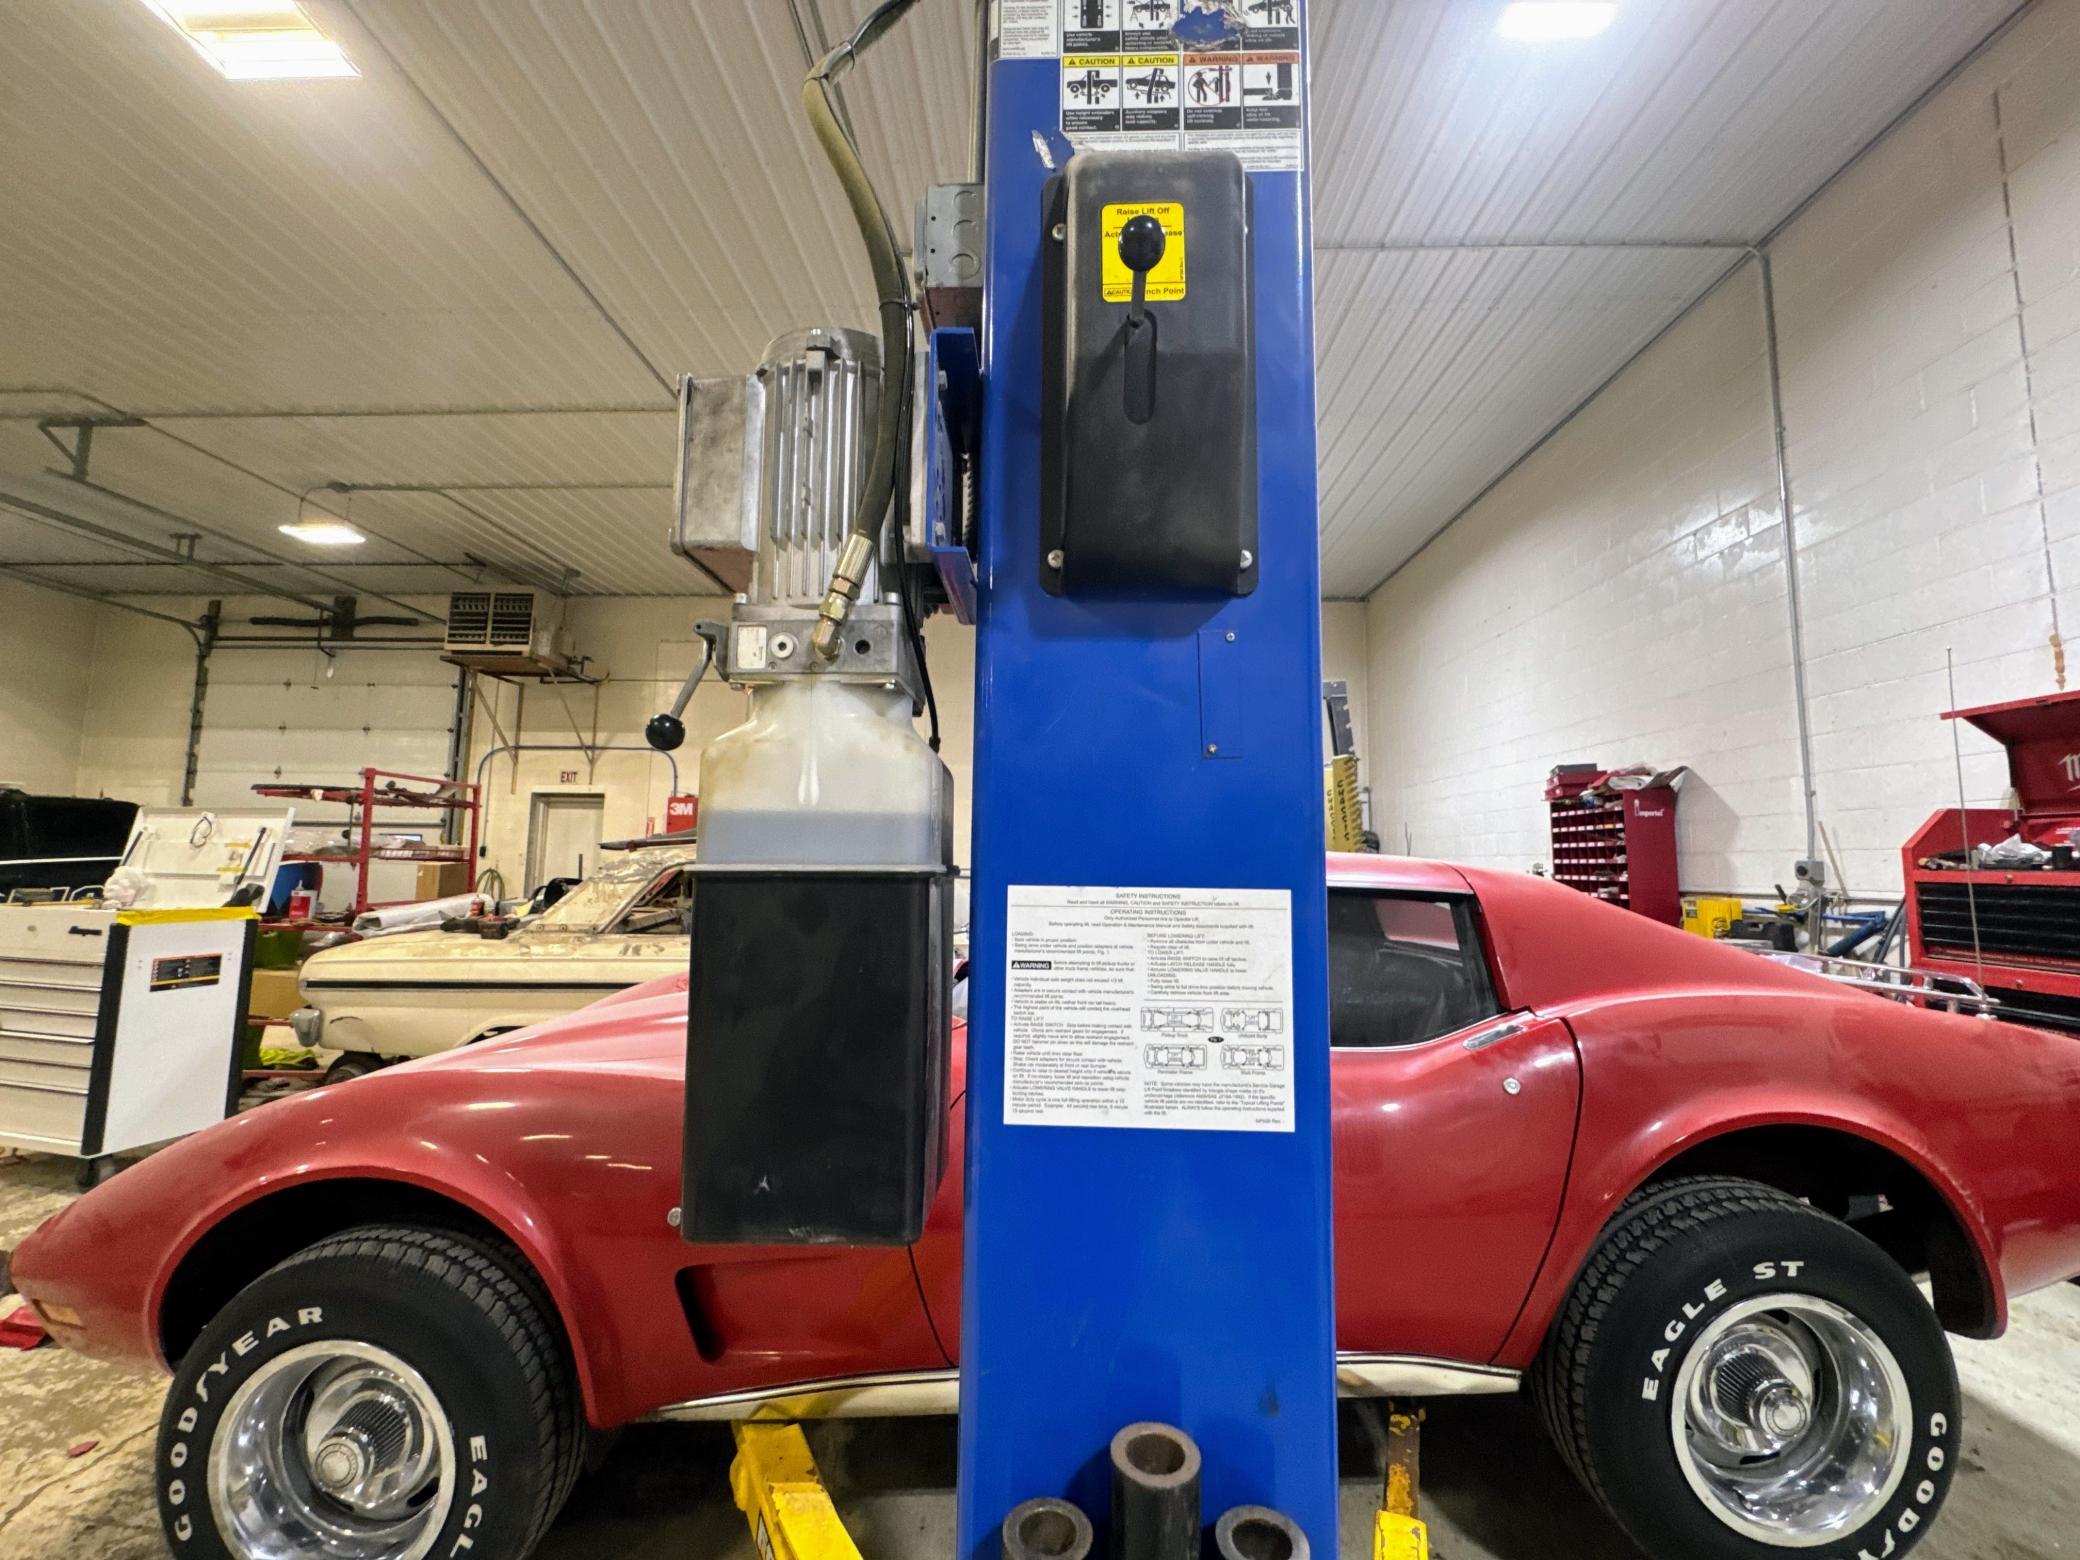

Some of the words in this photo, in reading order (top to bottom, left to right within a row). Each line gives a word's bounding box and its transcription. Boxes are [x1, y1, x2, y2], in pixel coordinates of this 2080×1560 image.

[560, 771, 578, 783] EXIT
[670, 802, 693, 815] 3M
[1641, 1278, 1727, 1401] EAGLE
[1753, 1261, 1804, 1280] ST
[168, 1307, 323, 1542] GOODYEAR
[449, 1435, 488, 1558] EAGL
